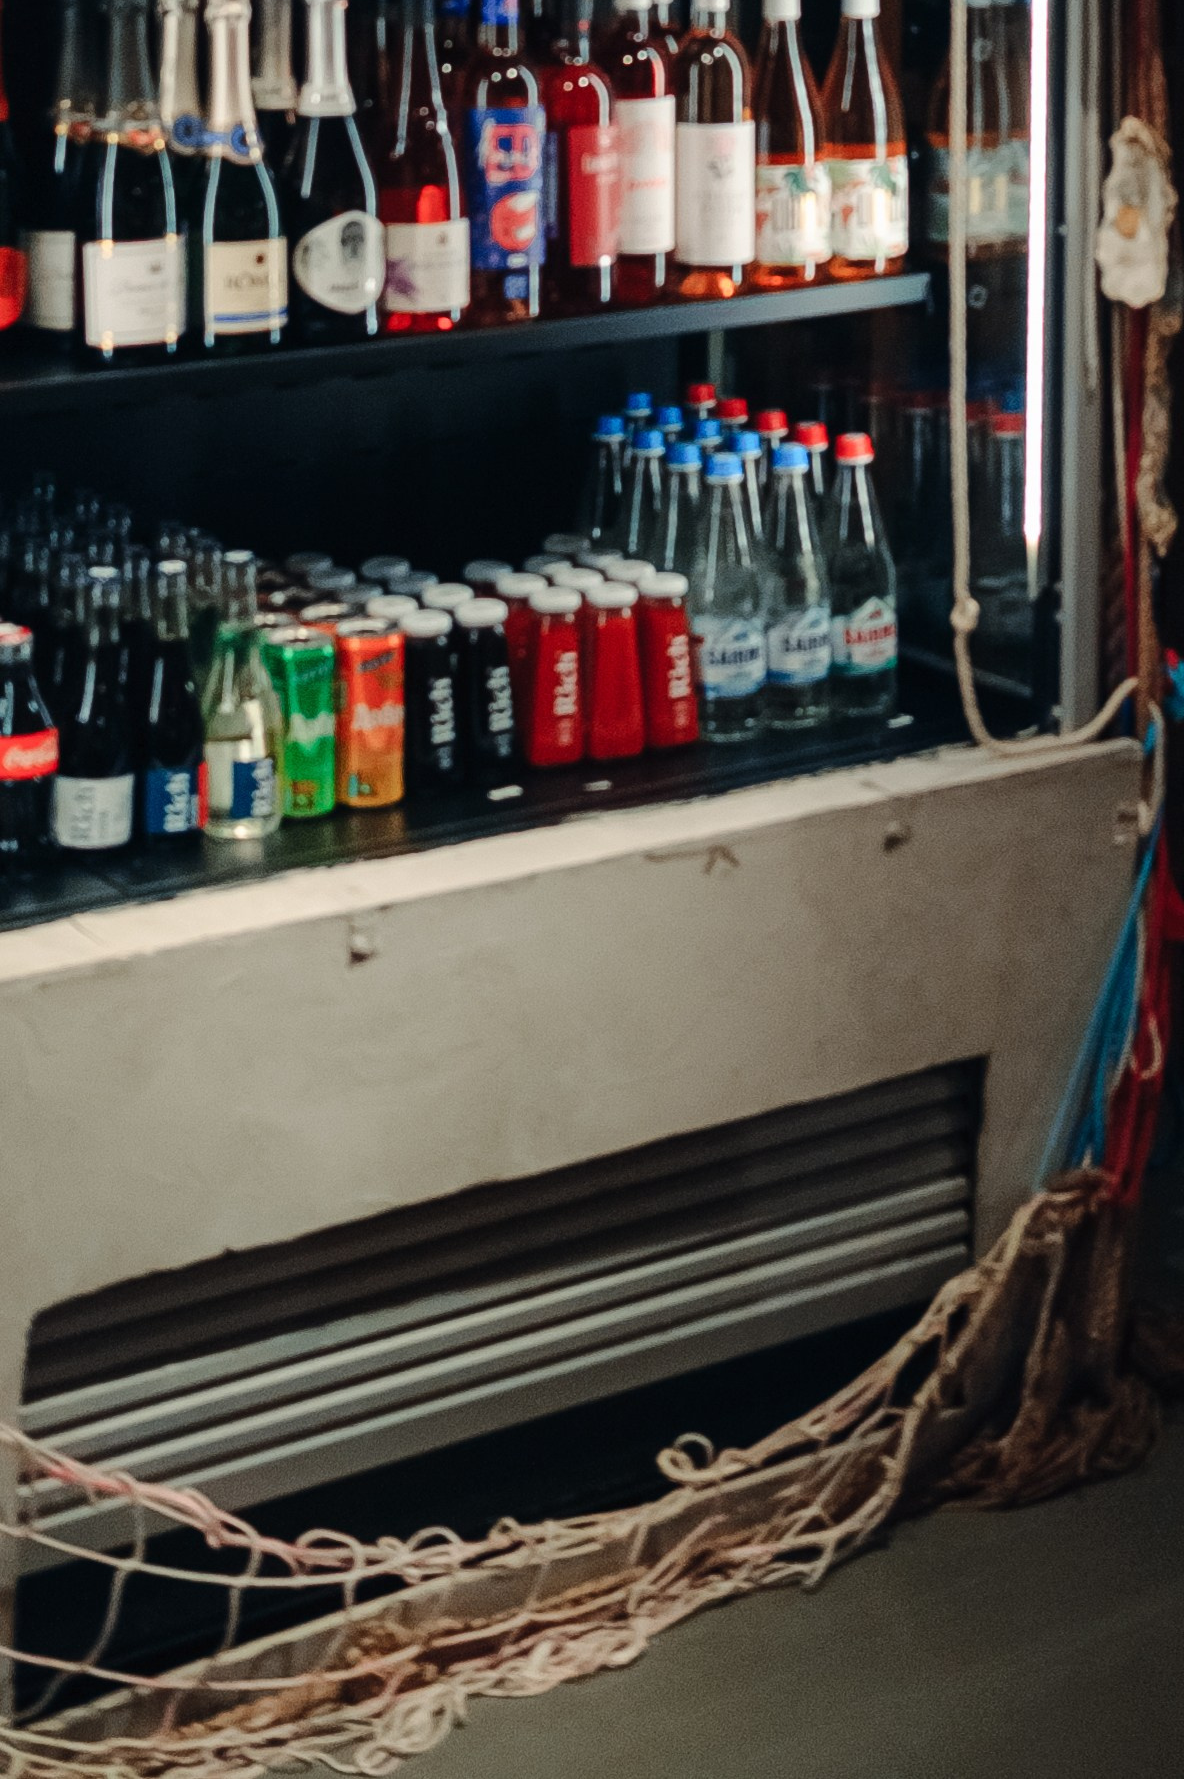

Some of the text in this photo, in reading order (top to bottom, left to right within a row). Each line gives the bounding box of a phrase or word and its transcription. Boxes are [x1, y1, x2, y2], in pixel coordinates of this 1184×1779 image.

[487, 665, 514, 732] Rich
[553, 650, 579, 716] Rich
[667, 633, 691, 699] Rich
[429, 676, 456, 745] Rich
